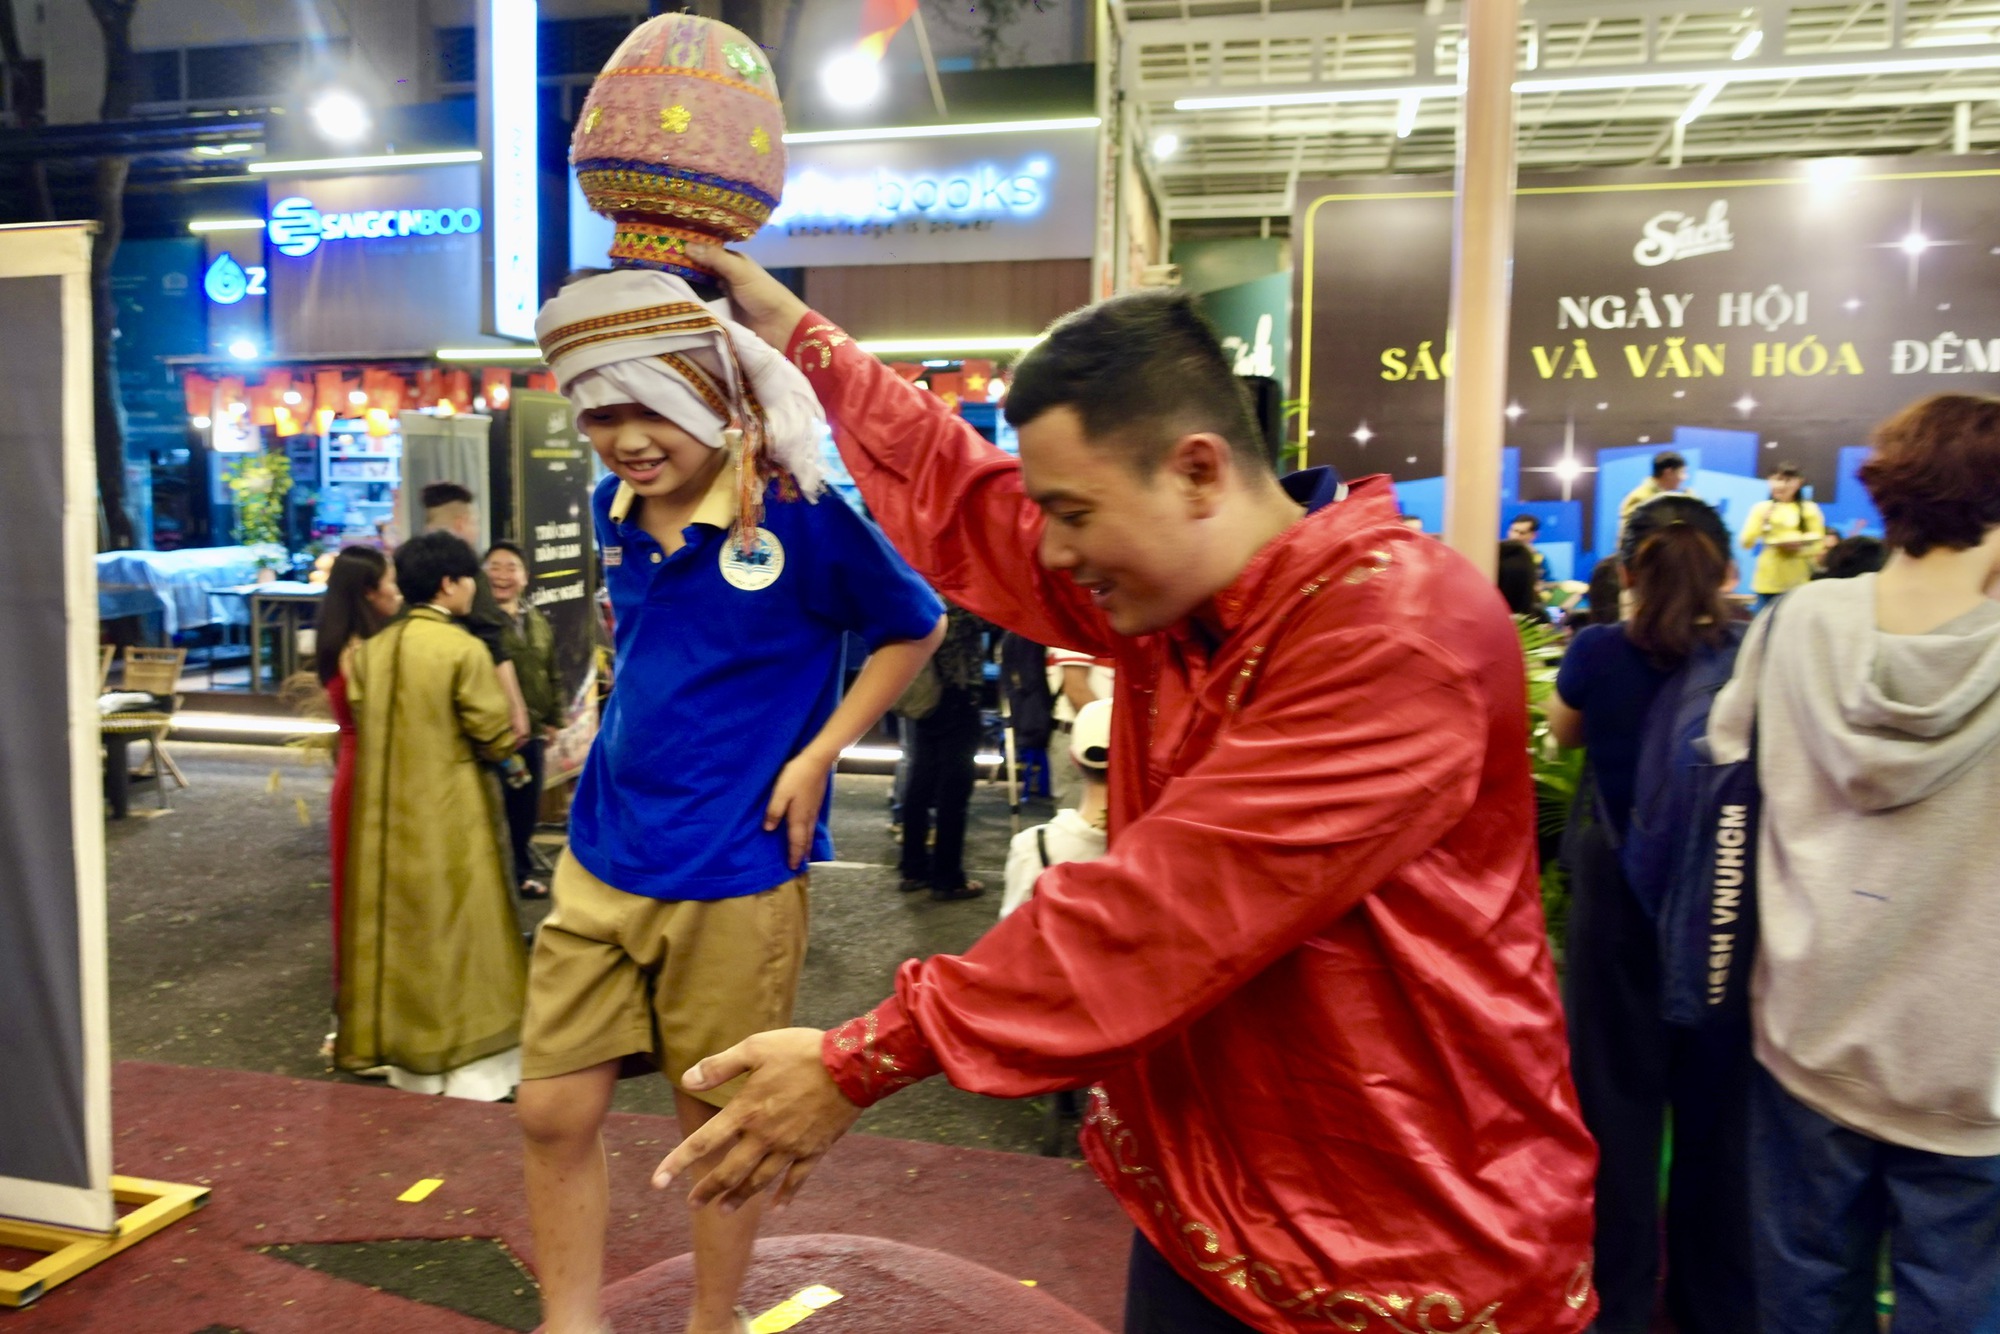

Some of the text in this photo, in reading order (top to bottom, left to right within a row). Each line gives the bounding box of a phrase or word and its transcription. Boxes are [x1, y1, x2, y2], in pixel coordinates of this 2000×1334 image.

[1634, 199, 1734, 267] Sách
[1557, 283, 1809, 332] NGÀY HỘI
[1531, 338, 1598, 380] VÀ
[1623, 336, 1726, 379] VĂN
[1751, 334, 1865, 378] HÓA
